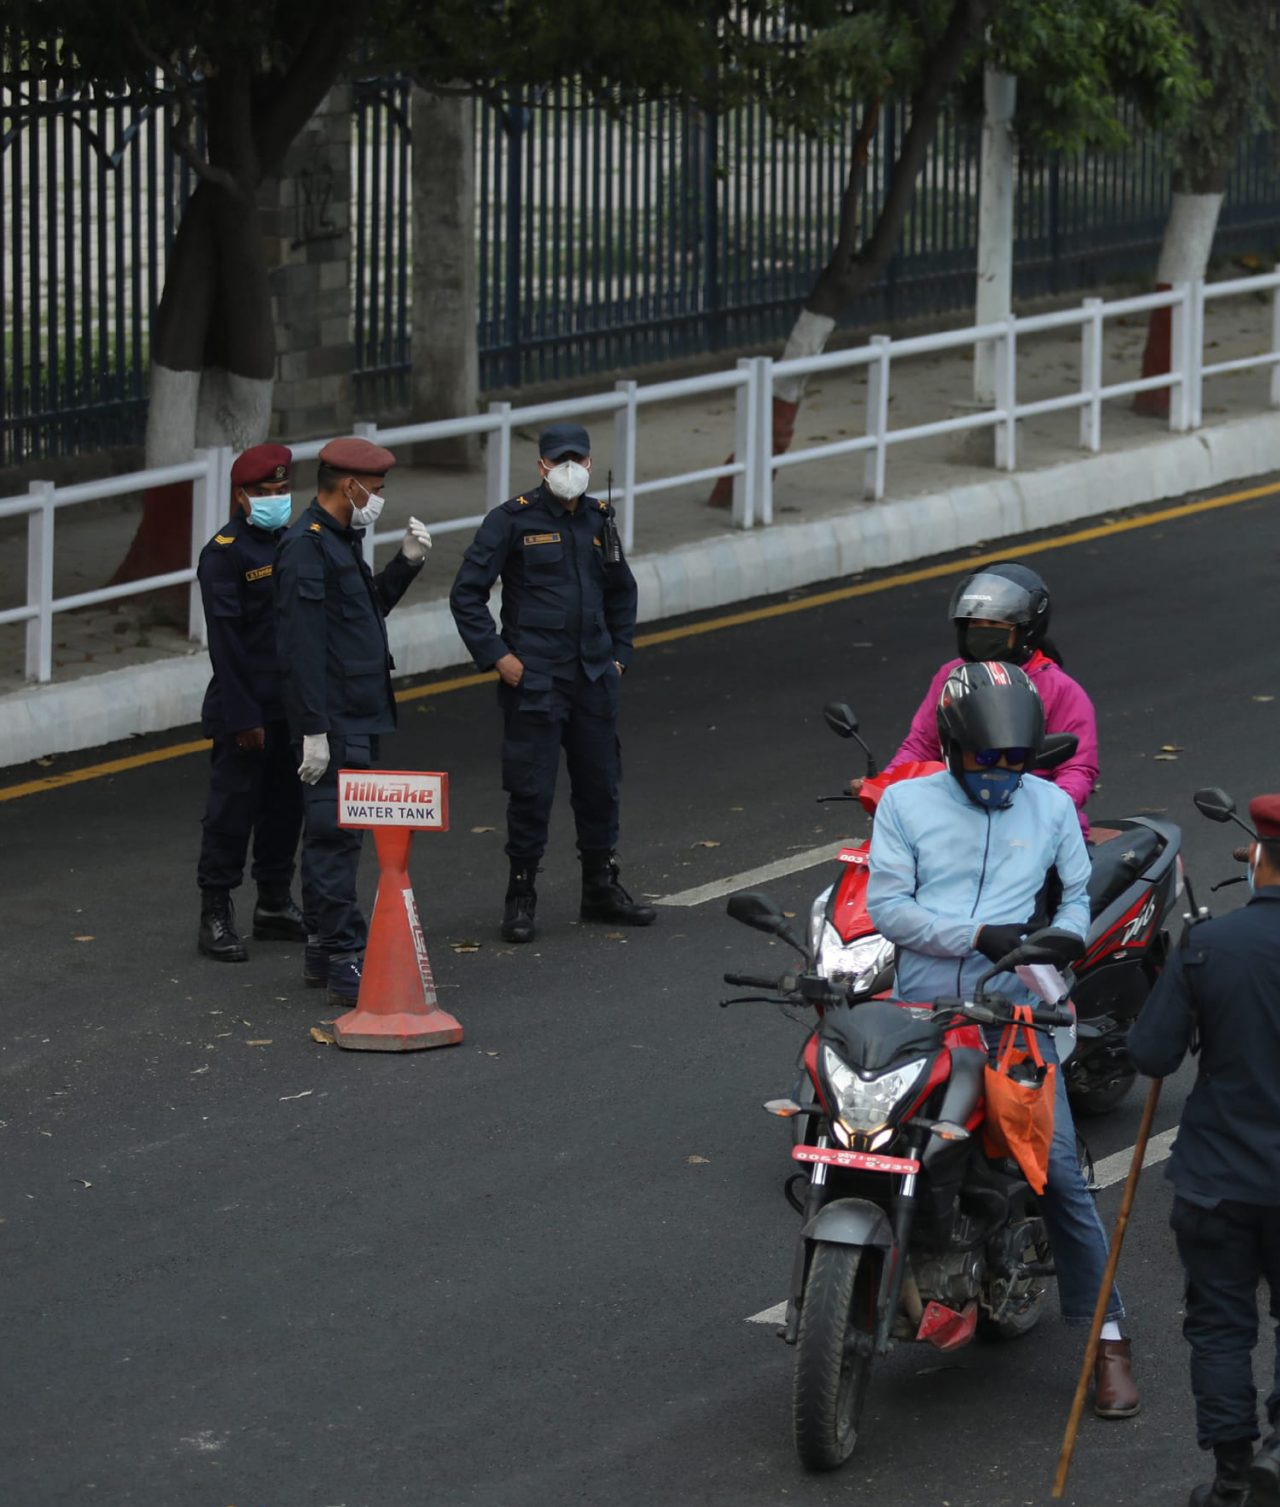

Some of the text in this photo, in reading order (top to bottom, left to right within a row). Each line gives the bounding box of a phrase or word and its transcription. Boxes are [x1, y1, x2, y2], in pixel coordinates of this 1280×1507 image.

[344, 782, 434, 803] Hilltake
[347, 806, 434, 819] WATER TANK
